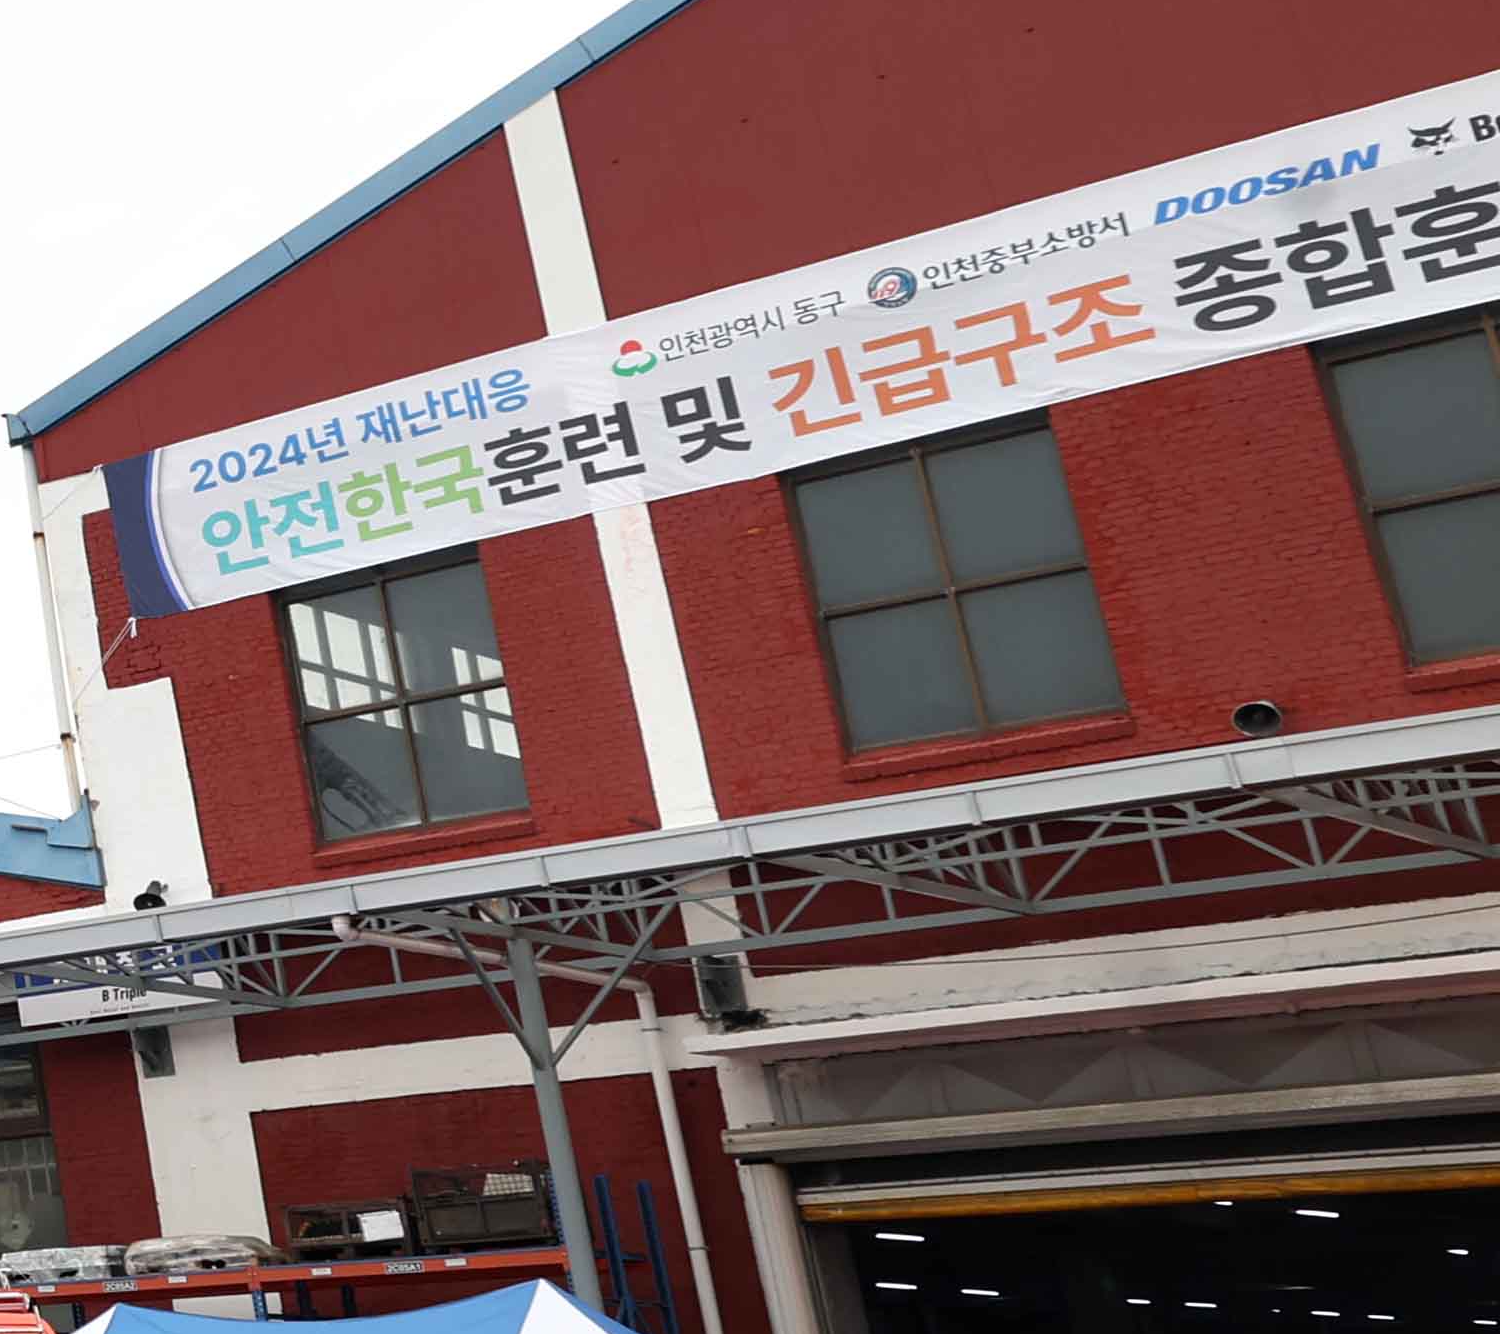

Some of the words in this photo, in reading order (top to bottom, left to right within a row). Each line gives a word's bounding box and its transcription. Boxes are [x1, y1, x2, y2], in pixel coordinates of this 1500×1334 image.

[1468, 114, 1500, 142] B
[1154, 143, 1380, 225] DOOSAN
[923, 211, 1131, 291] 인천중부소방서
[659, 305, 786, 364] 인천광역시
[793, 289, 846, 328] 동구
[189, 417, 349, 493] 2024년
[355, 368, 532, 447] 재난대응
[201, 401, 646, 575] 안전한국훈련
[660, 375, 752, 464] 및
[767, 274, 1157, 437] 긴급구조
